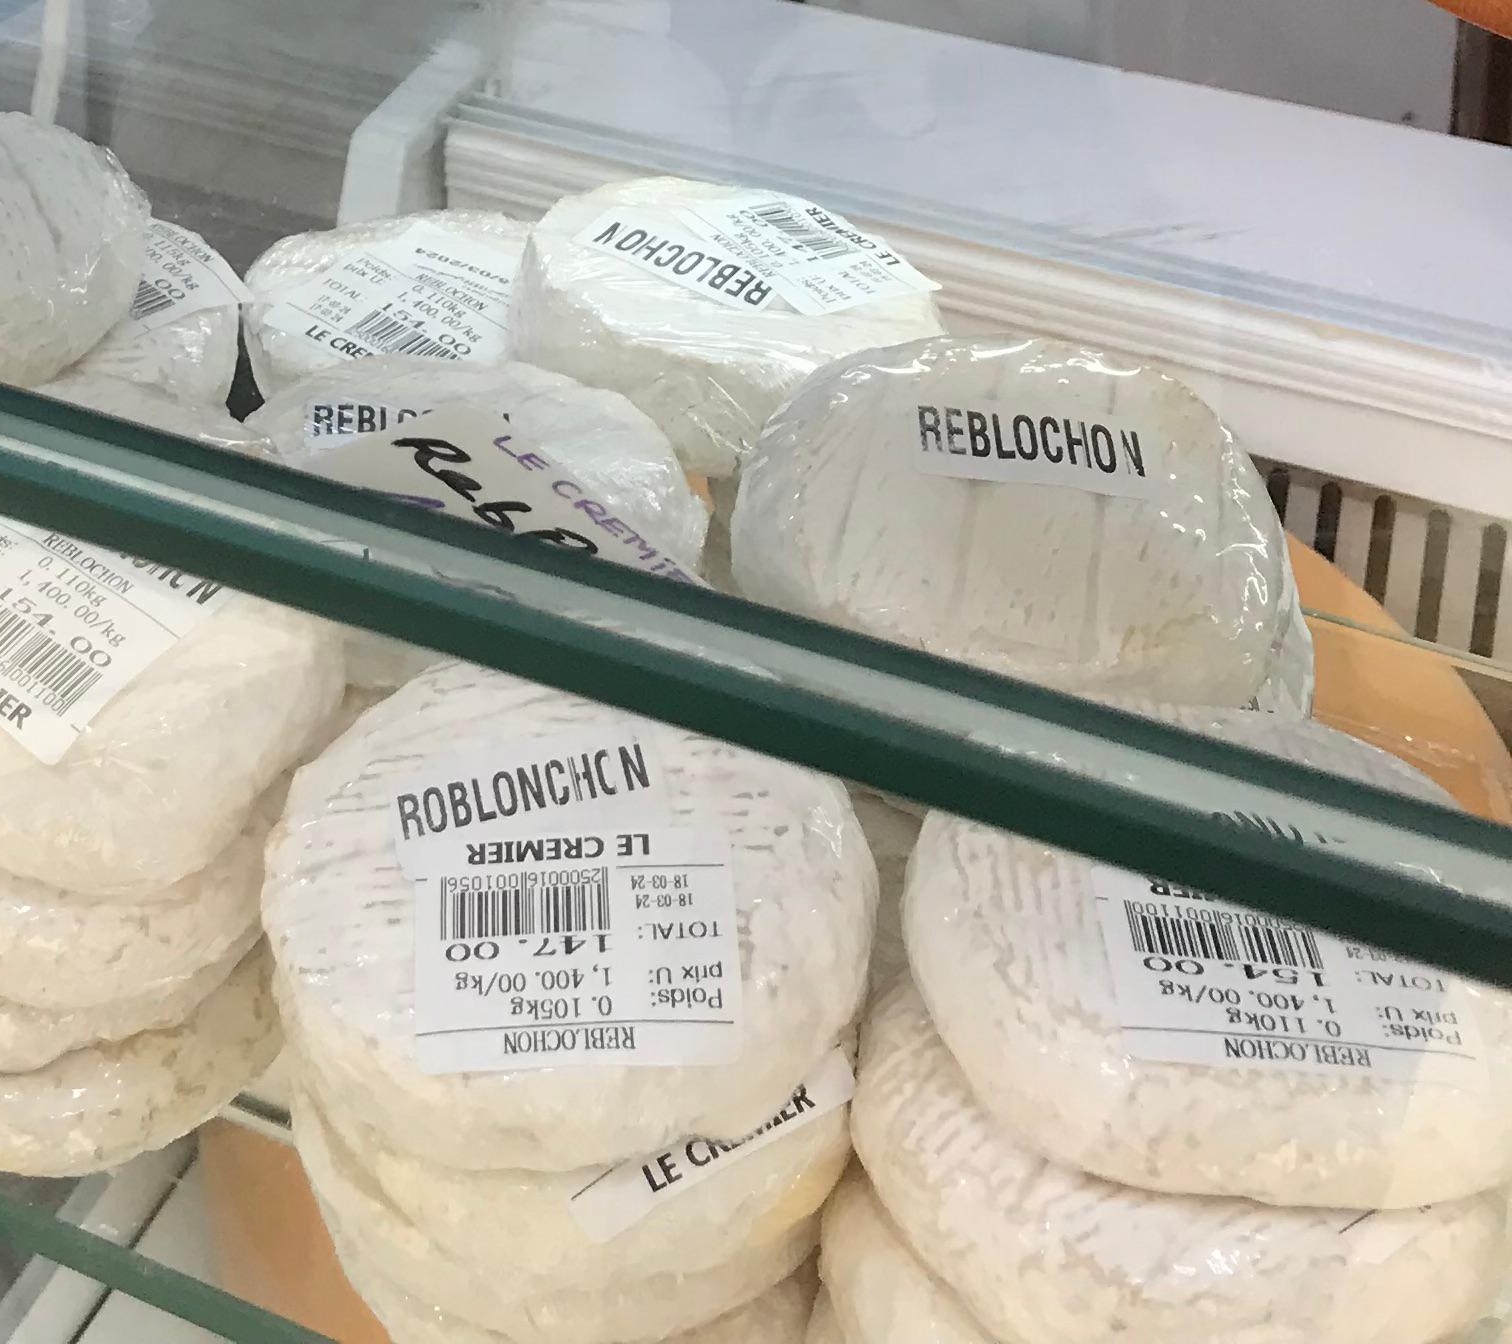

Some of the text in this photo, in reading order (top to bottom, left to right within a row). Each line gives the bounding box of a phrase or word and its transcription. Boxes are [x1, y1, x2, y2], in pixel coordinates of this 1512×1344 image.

[804, 207, 901, 266] LE CREMIER
[593, 220, 773, 305] REBLOCHON
[304, 324, 332, 343] LE
[916, 403, 1147, 479] REBLOCHON
[466, 833, 650, 866] LE CREMIER
[637, 920, 722, 940] TOTAL:
[647, 964, 672, 984] U:
[683, 961, 724, 980] prix
[649, 987, 724, 1009] Poids:
[1414, 1008, 1458, 1025] prix
[503, 1026, 637, 1054] REBLOCHON
[1383, 1022, 1463, 1045] Poids:
[1223, 1037, 1372, 1068] REBLOCHON
[641, 1151, 683, 1193] LE
